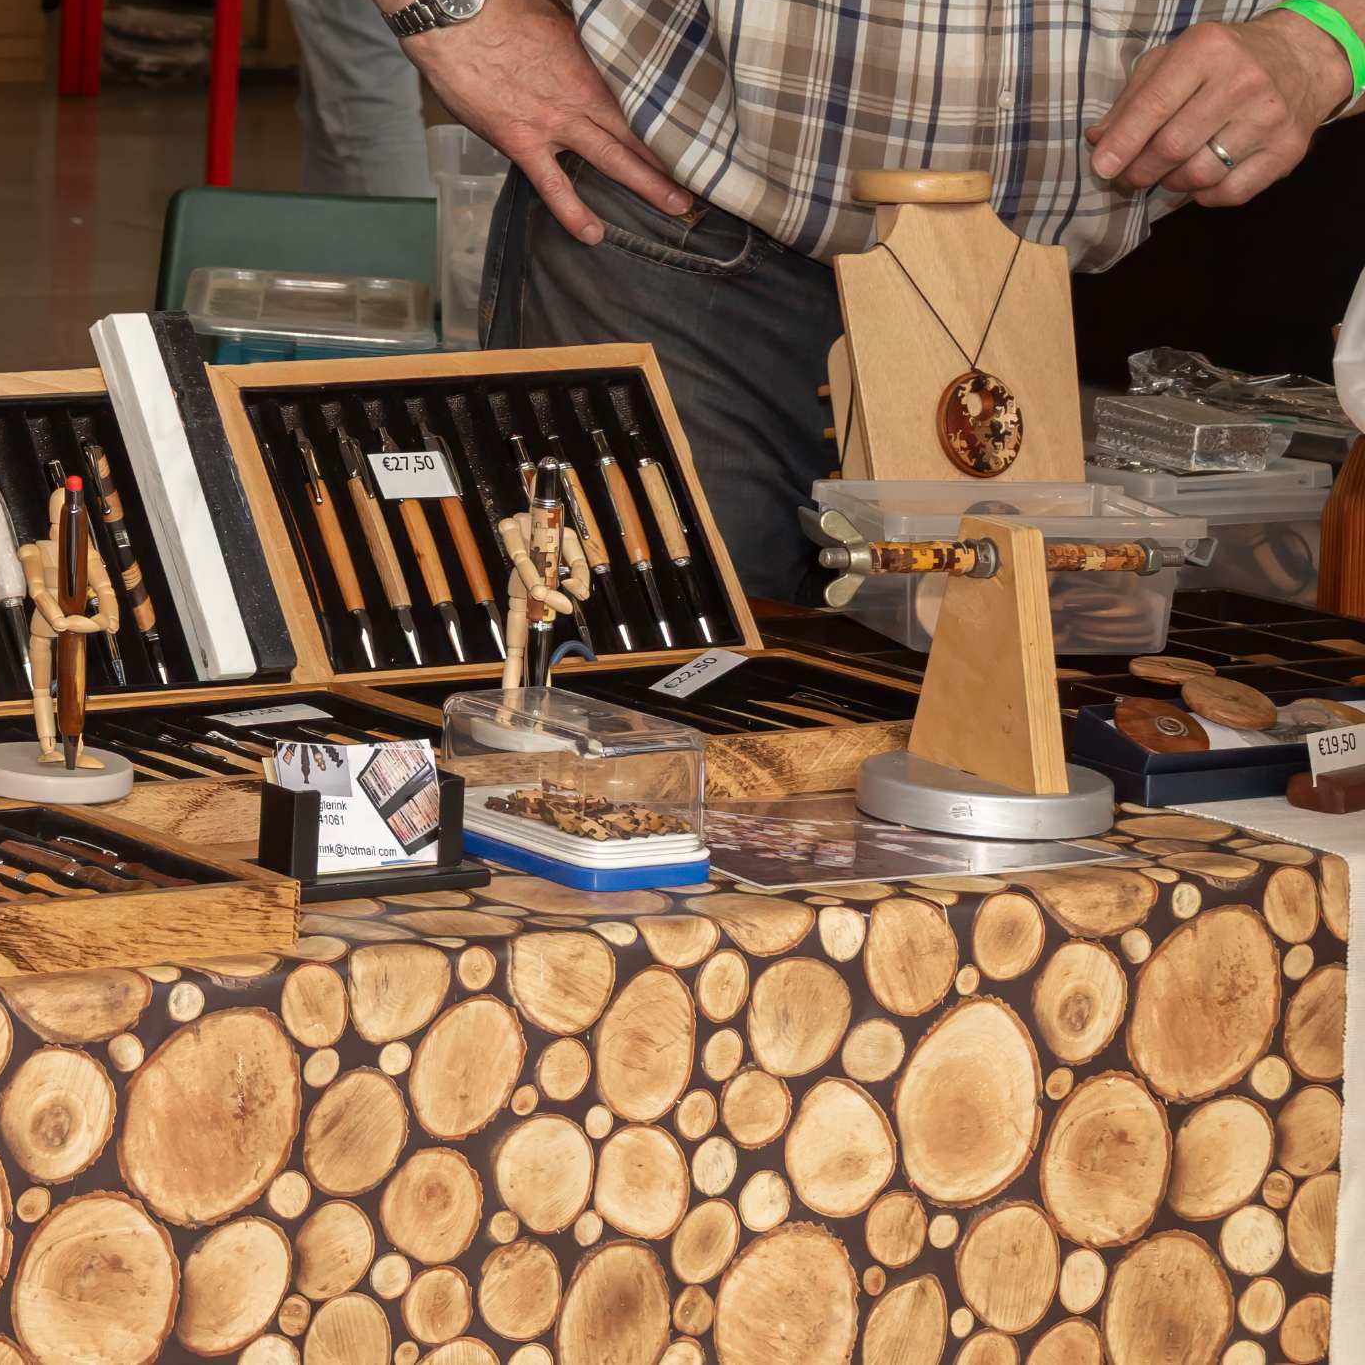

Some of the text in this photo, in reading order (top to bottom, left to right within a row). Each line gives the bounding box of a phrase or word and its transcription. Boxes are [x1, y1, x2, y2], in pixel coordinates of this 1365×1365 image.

[382, 455, 435, 473] €27,50
[663, 657, 718, 689] €22,50
[1318, 732, 1356, 756] €19,50
